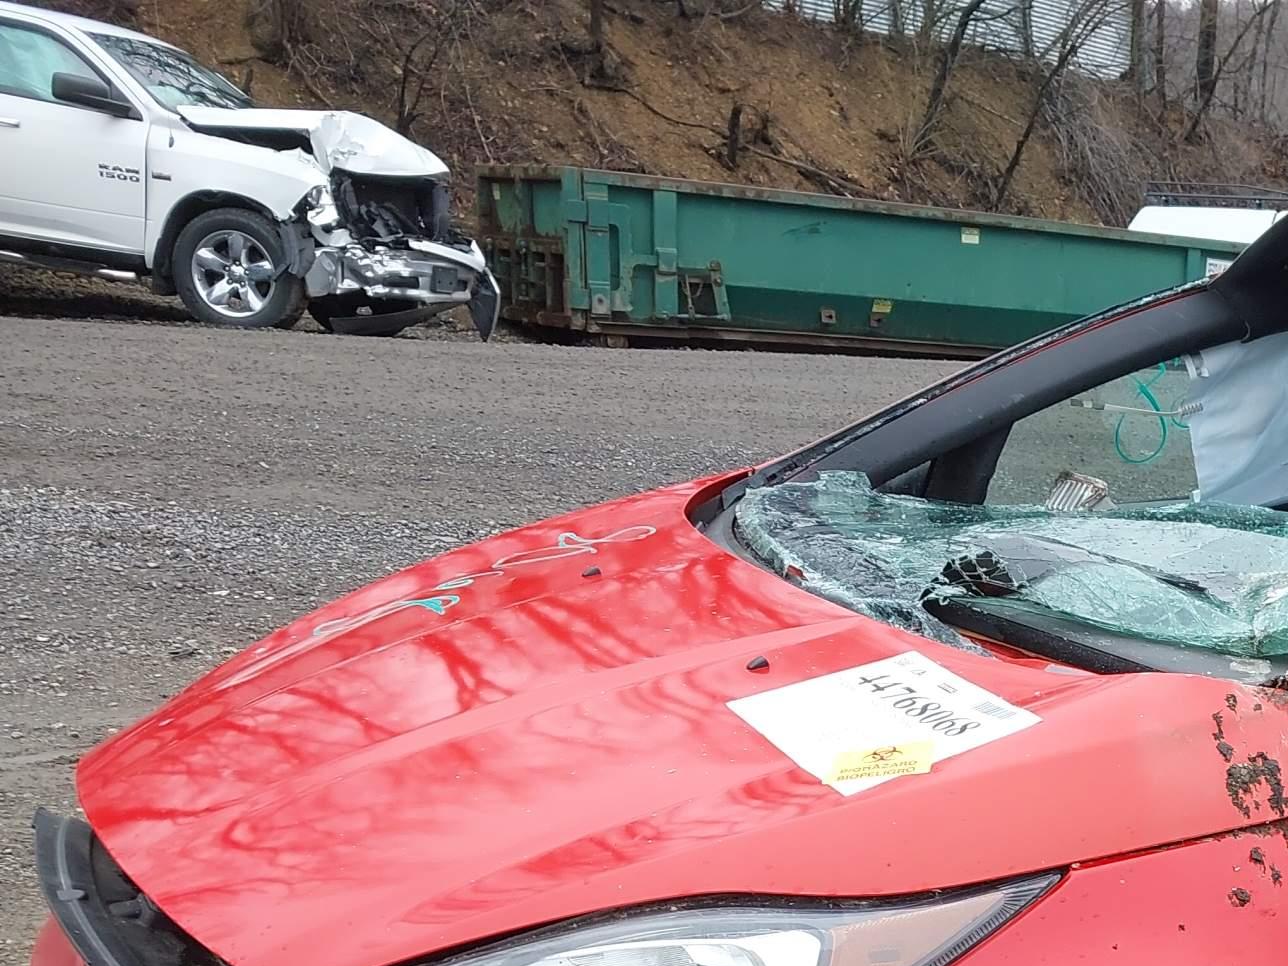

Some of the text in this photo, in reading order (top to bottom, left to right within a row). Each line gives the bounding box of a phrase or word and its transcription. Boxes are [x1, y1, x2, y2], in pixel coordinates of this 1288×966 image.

[99, 170, 140, 183] 1500
[857, 673, 982, 738] 44768068
[836, 766, 918, 782] BIOPELIGRO
[839, 759, 919, 774] BIOHAZARD
